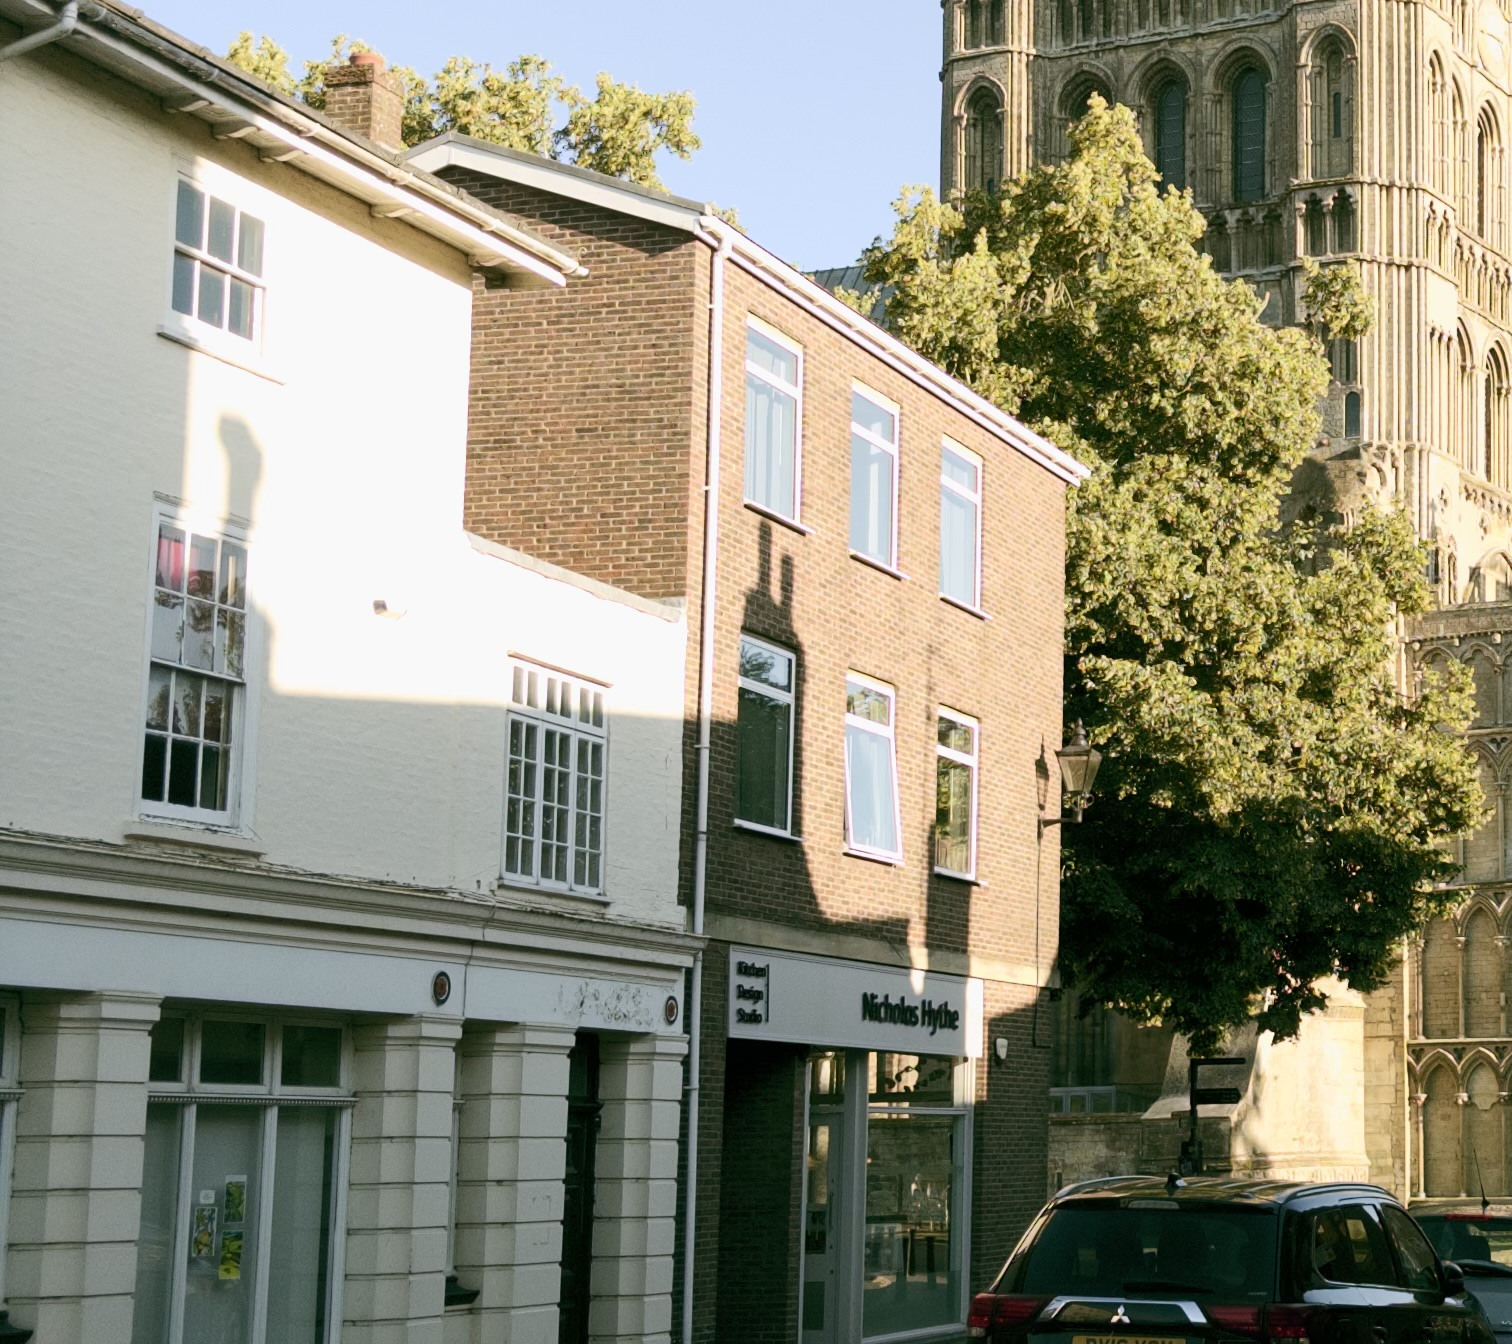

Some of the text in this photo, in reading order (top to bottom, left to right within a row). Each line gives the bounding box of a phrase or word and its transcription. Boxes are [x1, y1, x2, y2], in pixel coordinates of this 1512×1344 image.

[736, 960, 766, 978] Kitchen
[736, 984, 764, 1005] Design
[736, 1008, 763, 1025] Studio
[861, 992, 960, 1036] Nicholas Hythe
